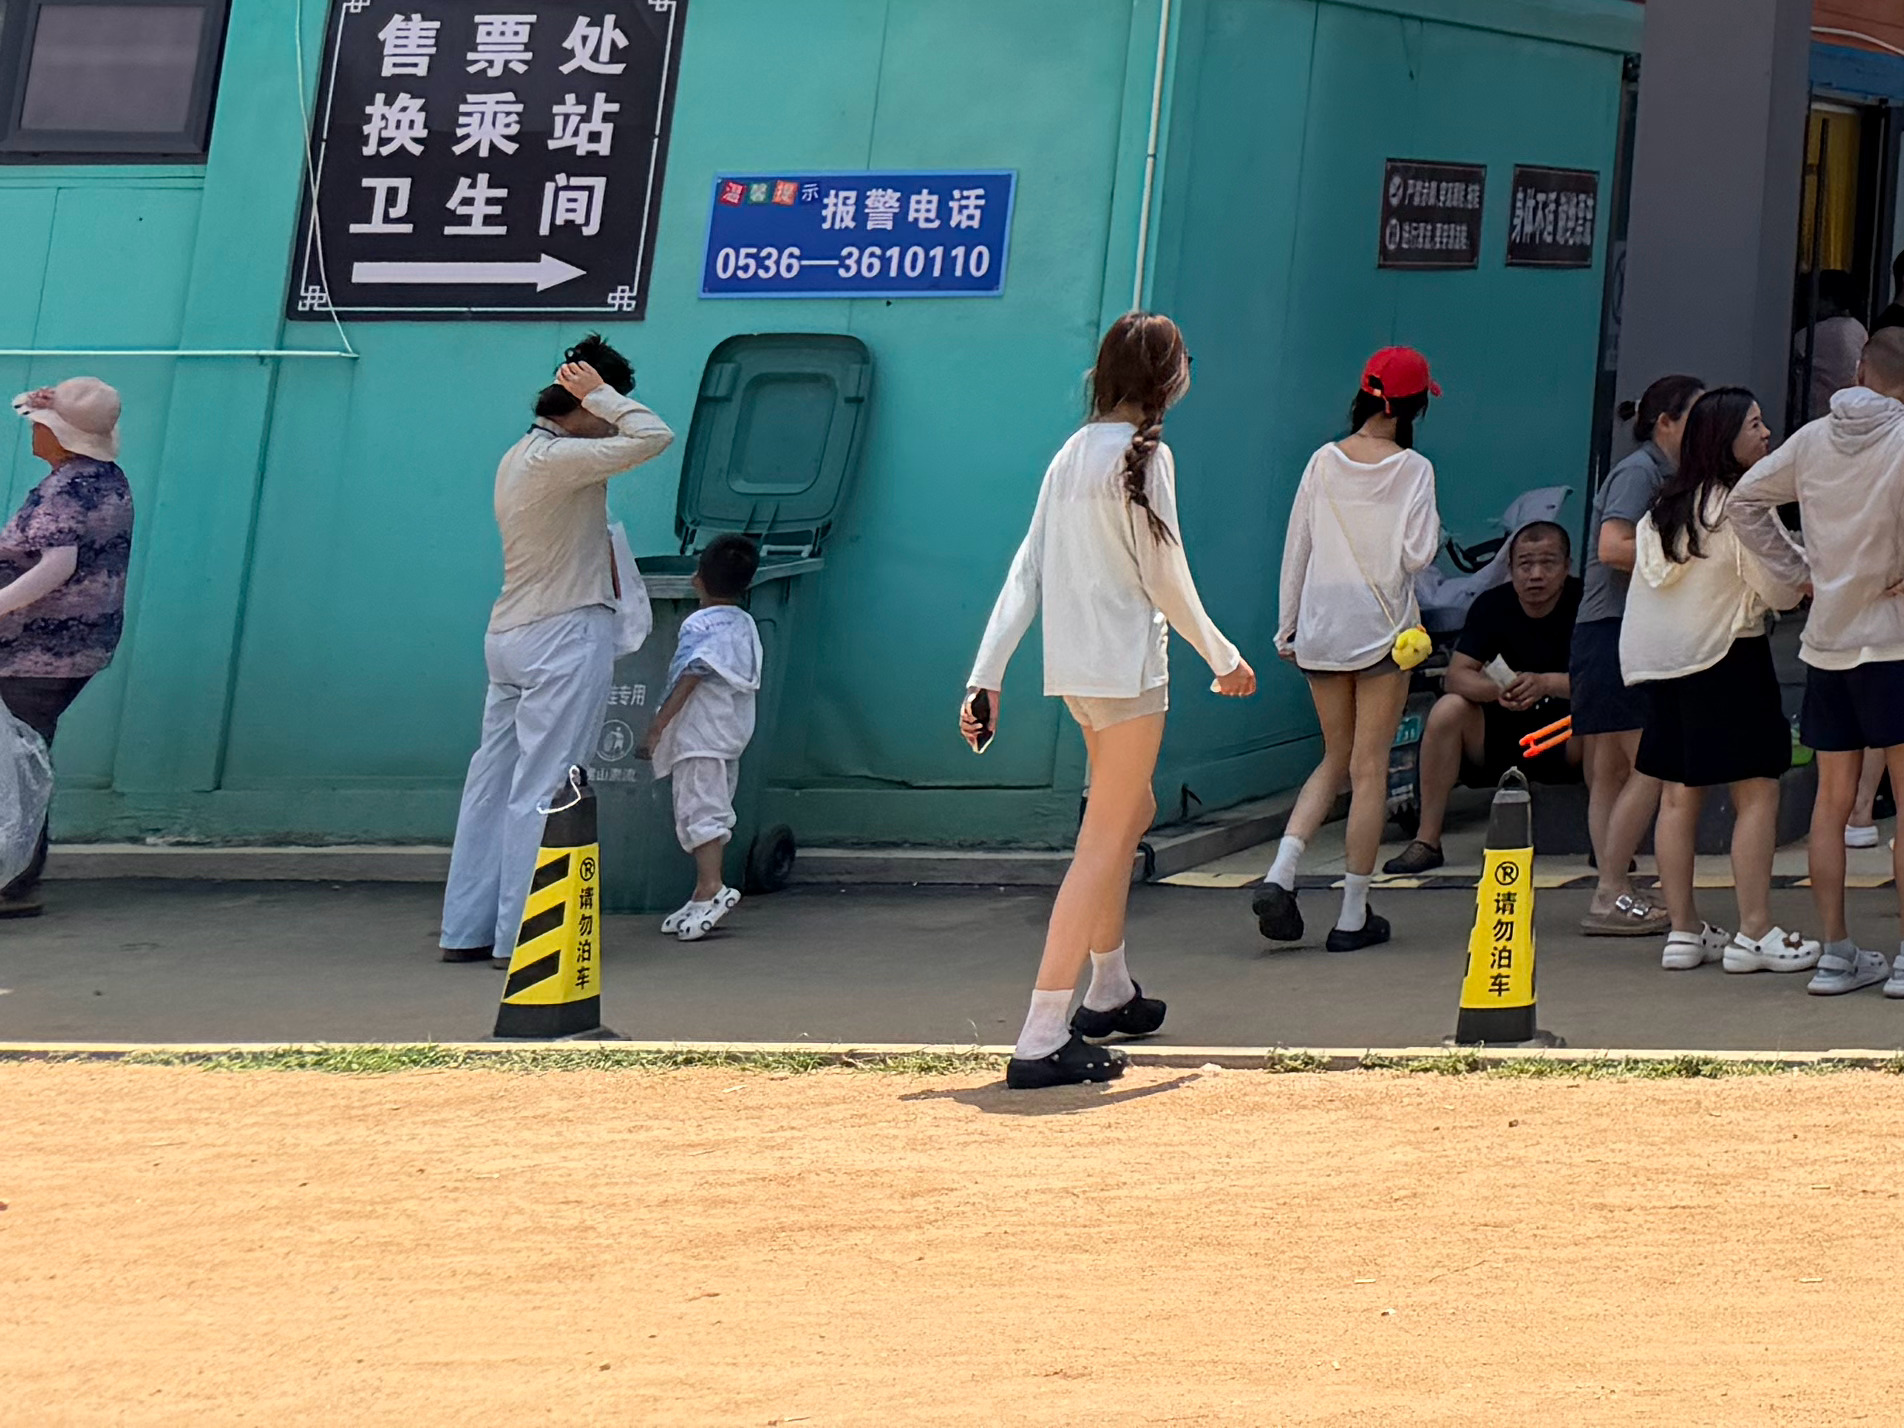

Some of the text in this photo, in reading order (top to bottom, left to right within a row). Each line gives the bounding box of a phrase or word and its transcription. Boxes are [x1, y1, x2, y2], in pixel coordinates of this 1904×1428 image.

[378, 13, 630, 77] 售票处
[362, 91, 620, 157] 换乘站
[349, 172, 607, 236] 卫生间
[822, 187, 986, 231] 报警电话
[574, 886, 595, 991] 请勿泊车
[1488, 892, 1518, 997] 请勿泊车
